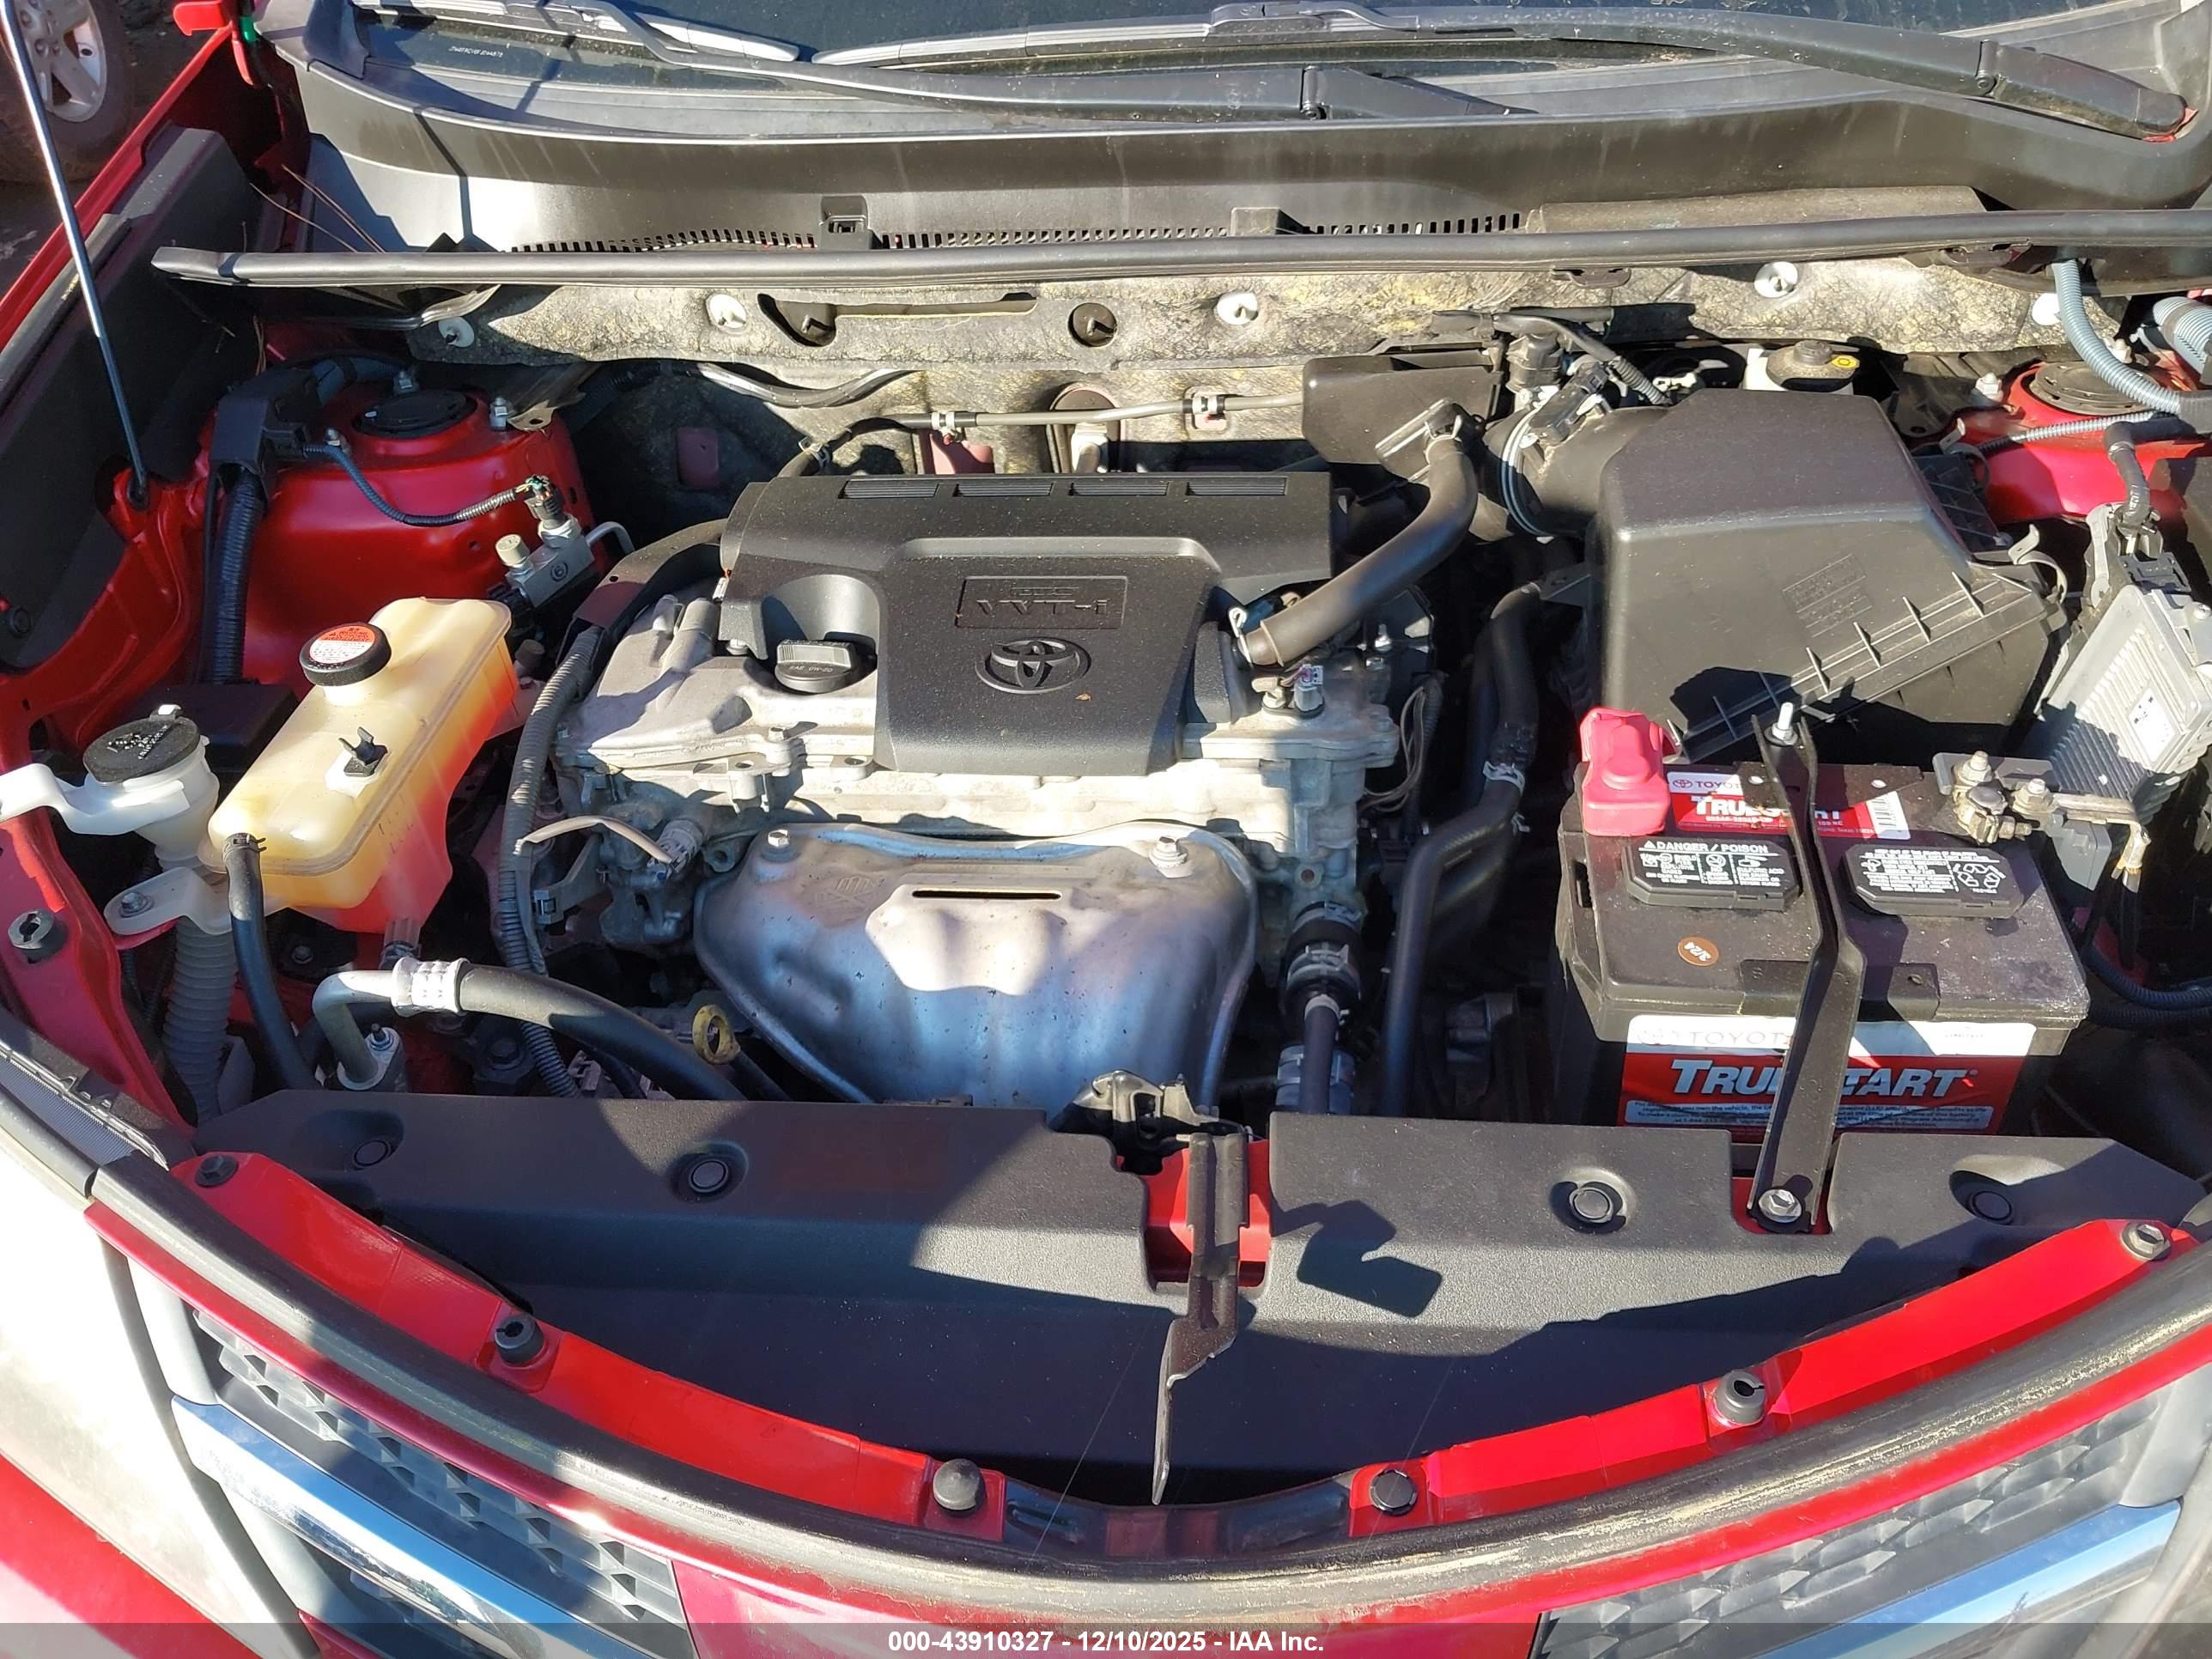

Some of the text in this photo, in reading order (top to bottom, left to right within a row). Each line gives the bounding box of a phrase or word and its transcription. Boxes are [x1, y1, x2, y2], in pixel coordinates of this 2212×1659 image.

[1695, 781, 1741, 789] TOYOT
[1656, 841, 1709, 852] DANGER
[1721, 844, 1769, 854] POISON
